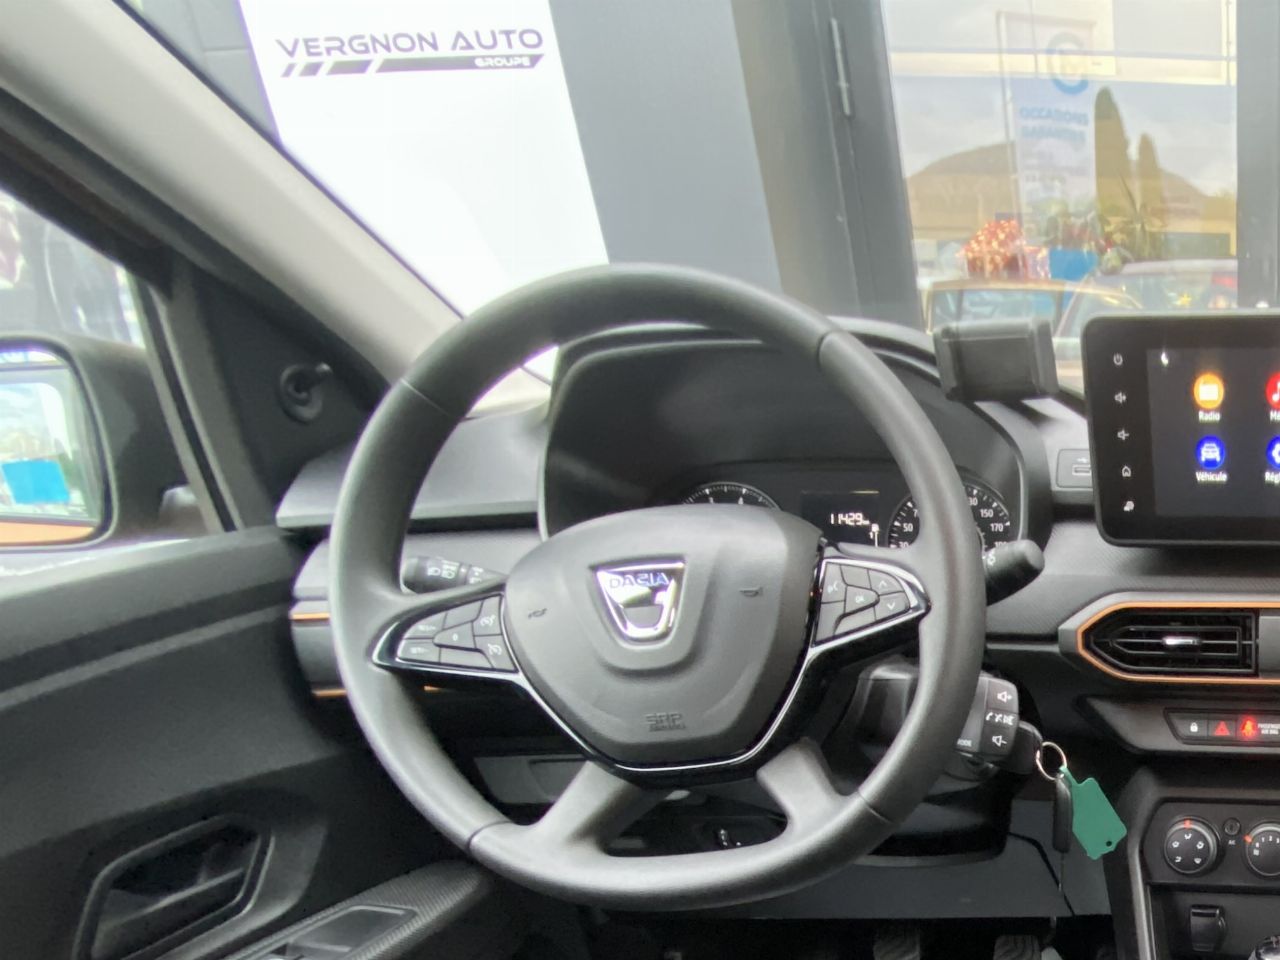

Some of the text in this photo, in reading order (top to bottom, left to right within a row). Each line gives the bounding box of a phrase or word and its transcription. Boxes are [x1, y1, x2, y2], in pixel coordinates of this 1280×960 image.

[275, 29, 543, 58] VERGNON AUTO
[474, 56, 531, 67] GROUPE
[1198, 411, 1221, 421] Radio
[1196, 471, 1228, 482] Véhicule
[968, 496, 978, 506] 30
[980, 508, 994, 518] 150
[903, 523, 914, 532] 50
[990, 522, 1004, 532] 170
[610, 572, 669, 589] DACIA
